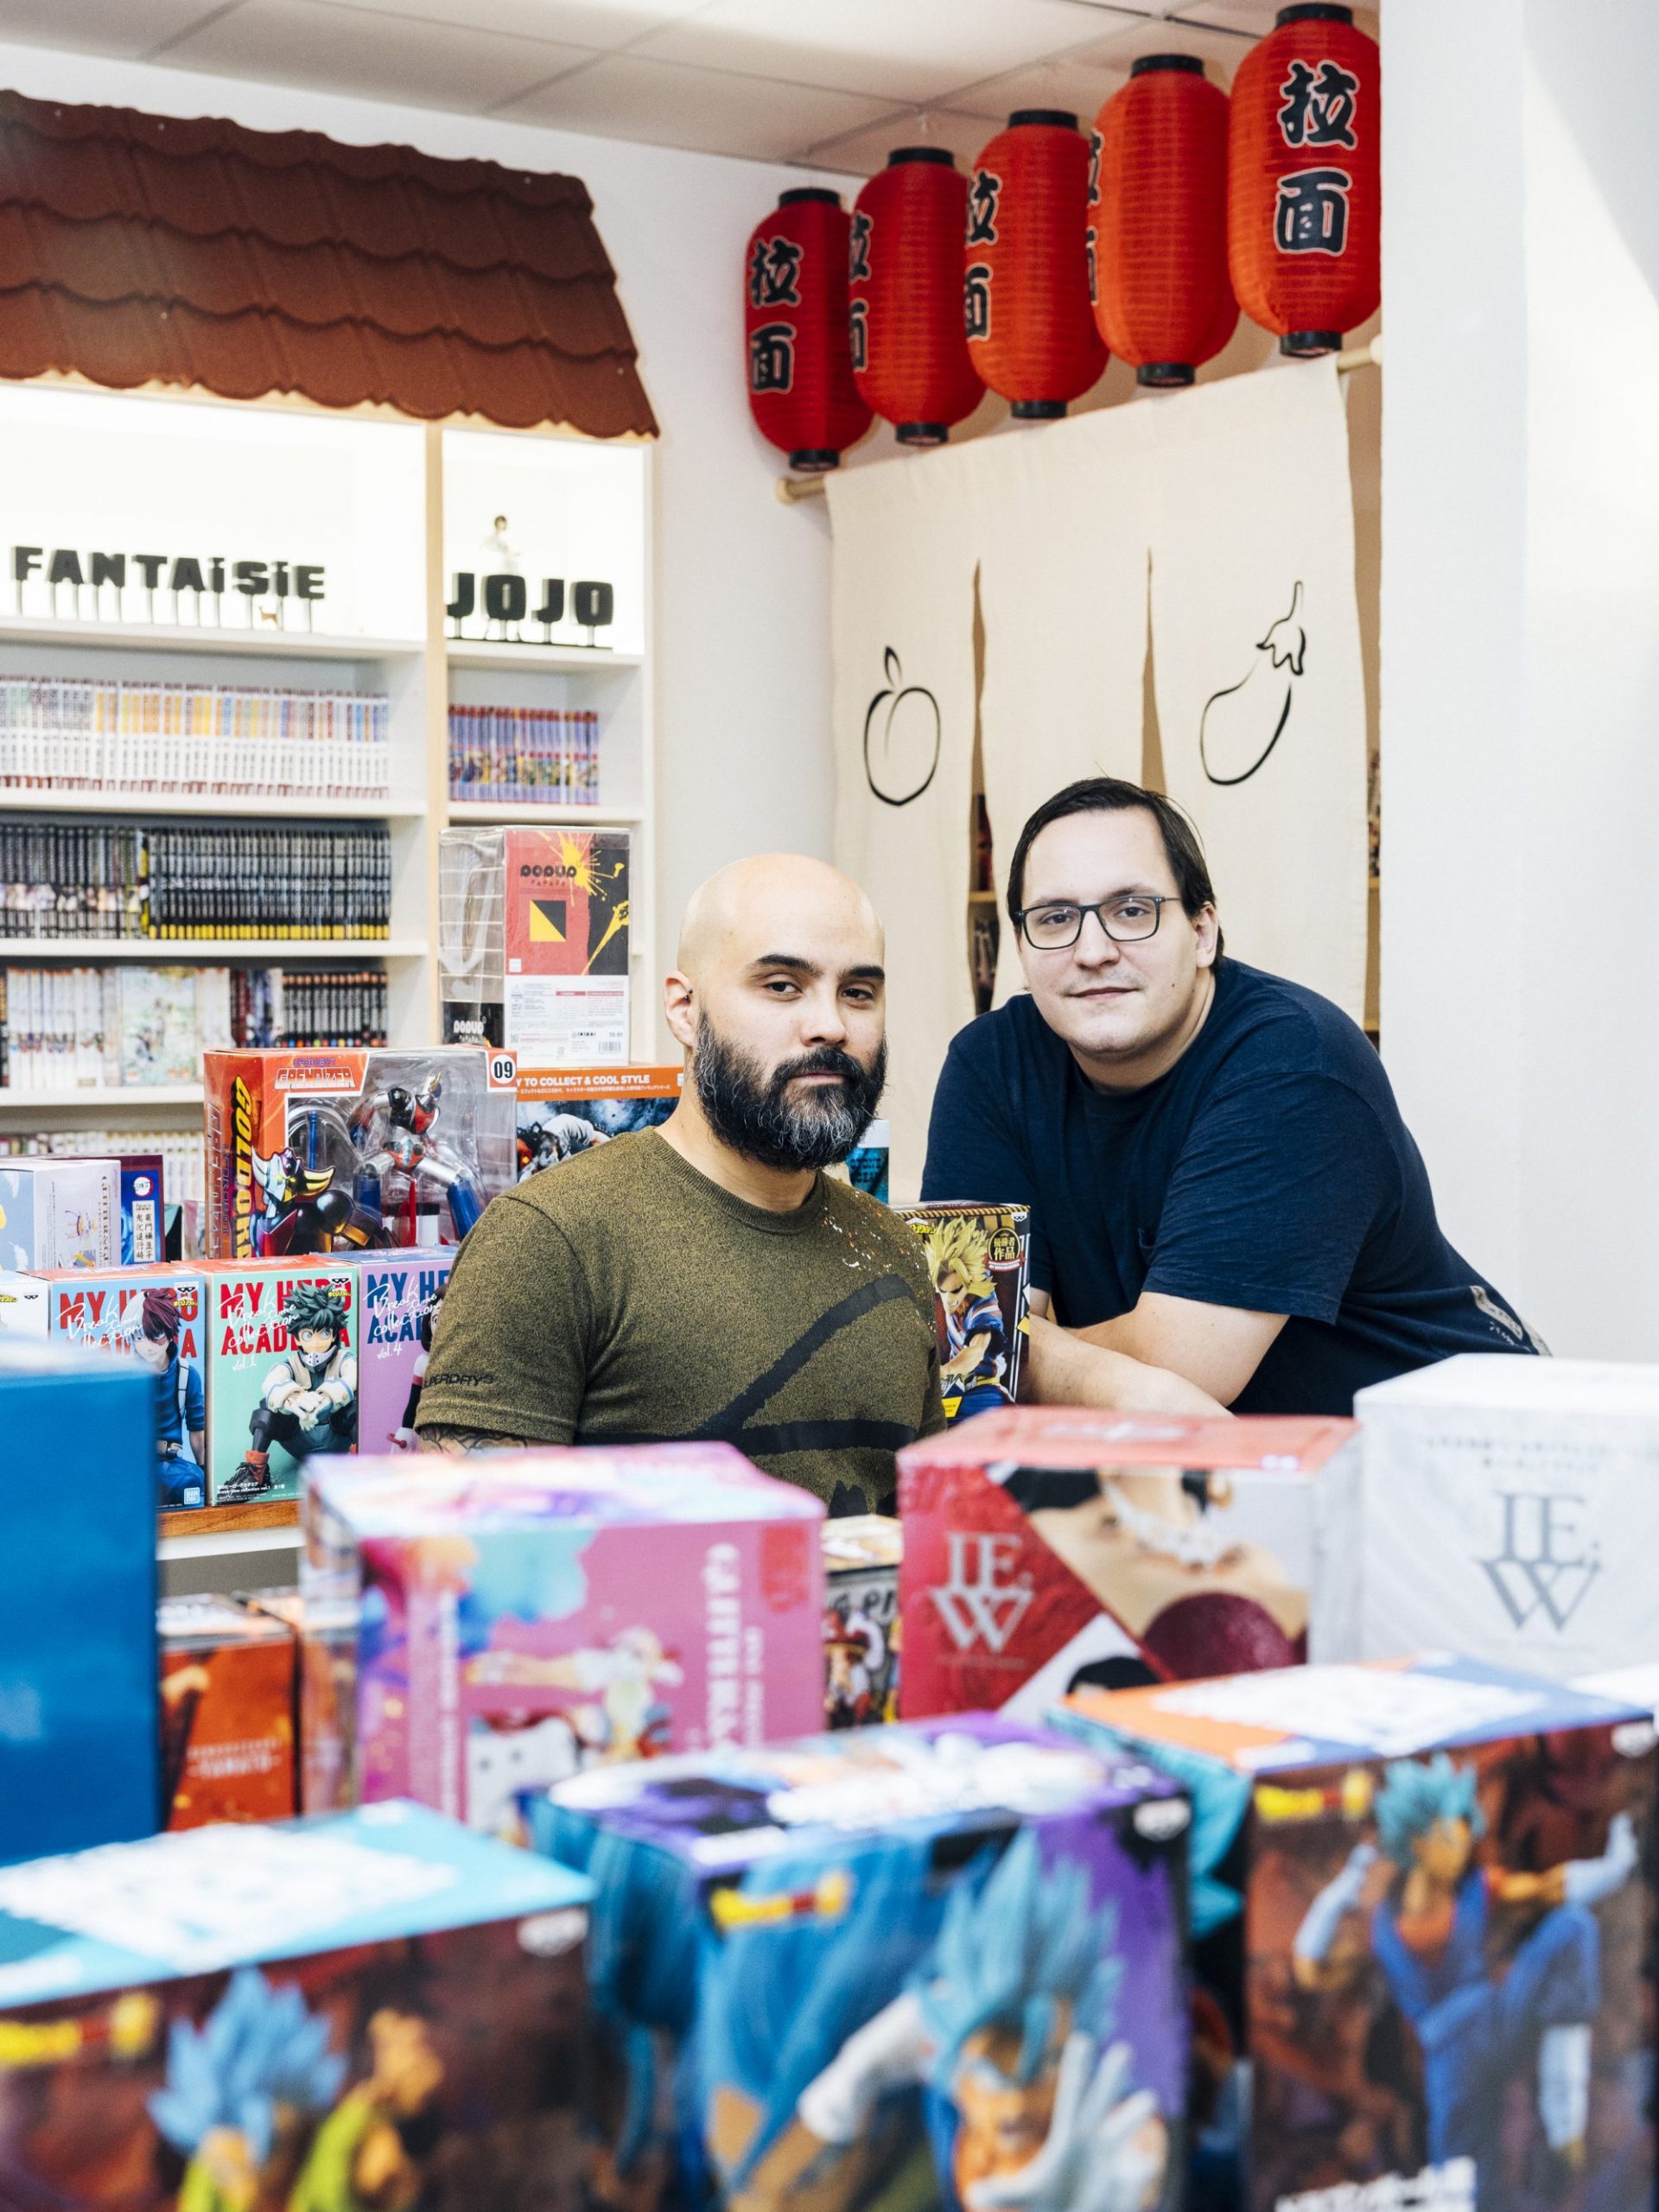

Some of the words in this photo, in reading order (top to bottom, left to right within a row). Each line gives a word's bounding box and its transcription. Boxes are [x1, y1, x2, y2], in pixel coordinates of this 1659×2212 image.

[447, 572, 613, 626] JOJO
[493, 1061, 513, 1078] 09
[524, 1077, 537, 1087] TO
[539, 1076, 581, 1087] COLLECT
[584, 1076, 590, 1085] &
[593, 1075, 619, 1085] COOL
[620, 1074, 650, 1084] STYLE
[216, 1286, 277, 1330] Break
[220, 1282, 264, 1319] MY
[363, 1276, 419, 1319] Break
[367, 1272, 408, 1308] MY
[407, 1294, 437, 1312] time
[56, 1295, 119, 1340] Break
[60, 1291, 106, 1330] MY
[264, 1304, 296, 1324] time
[373, 1303, 441, 1337] collection
[227, 1314, 299, 1349] collection
